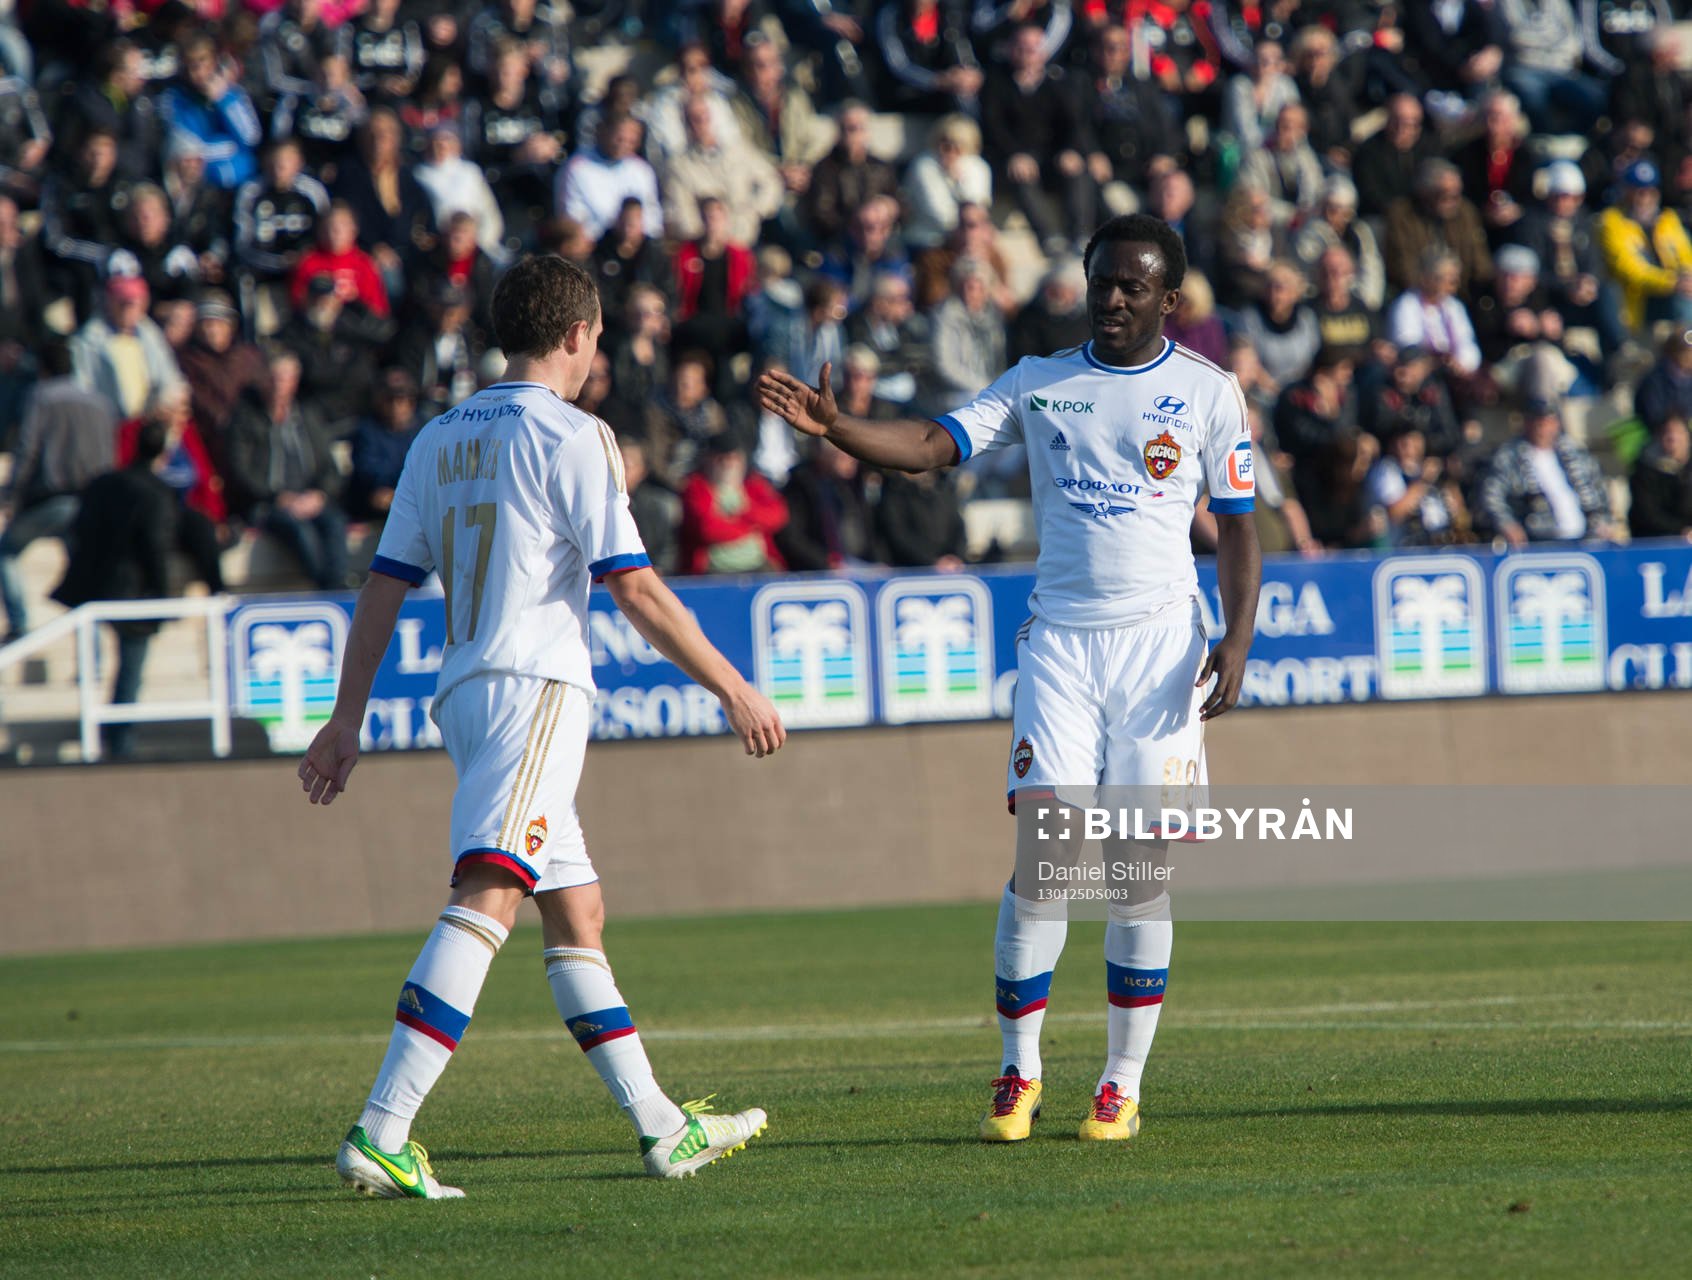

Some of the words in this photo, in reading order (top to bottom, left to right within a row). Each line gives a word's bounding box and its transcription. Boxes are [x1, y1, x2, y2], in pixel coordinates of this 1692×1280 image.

[1052, 400, 1095, 414] КРОК
[1143, 411, 1193, 432] HYUNDAI
[1148, 444, 1178, 461] ЦСКА
[1052, 478, 1143, 495] ЭРОФЛОТ
[442, 503, 497, 645] 17
[1638, 562, 1692, 618] L
[1124, 976, 1164, 987] ЦСКА
